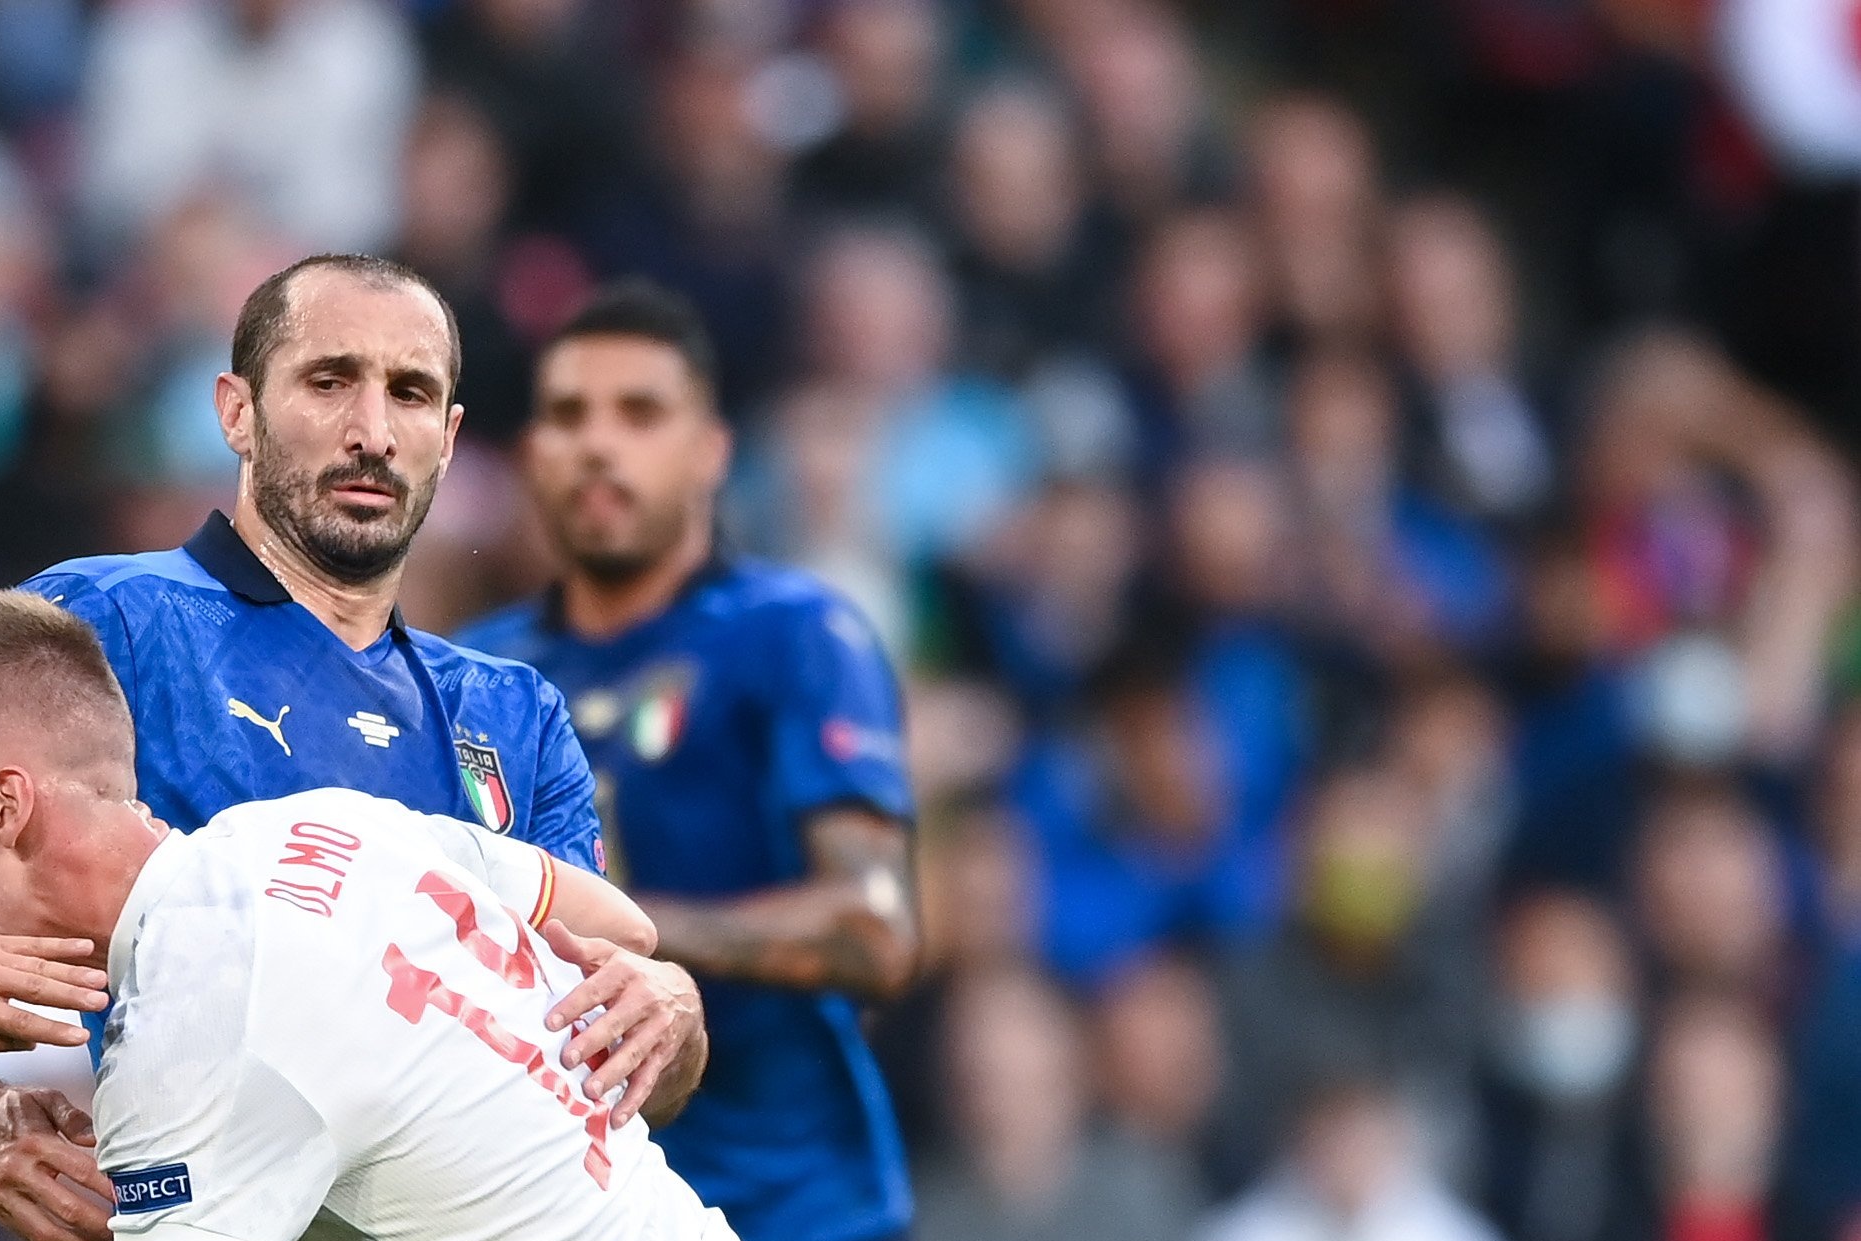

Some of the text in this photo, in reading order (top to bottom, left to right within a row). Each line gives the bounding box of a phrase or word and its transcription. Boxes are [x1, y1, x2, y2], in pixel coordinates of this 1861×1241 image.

[455, 747, 494, 768] TALIA
[265, 822, 362, 918] OLMO
[381, 869, 613, 1192] 14
[115, 1174, 188, 1204] RESPECT
